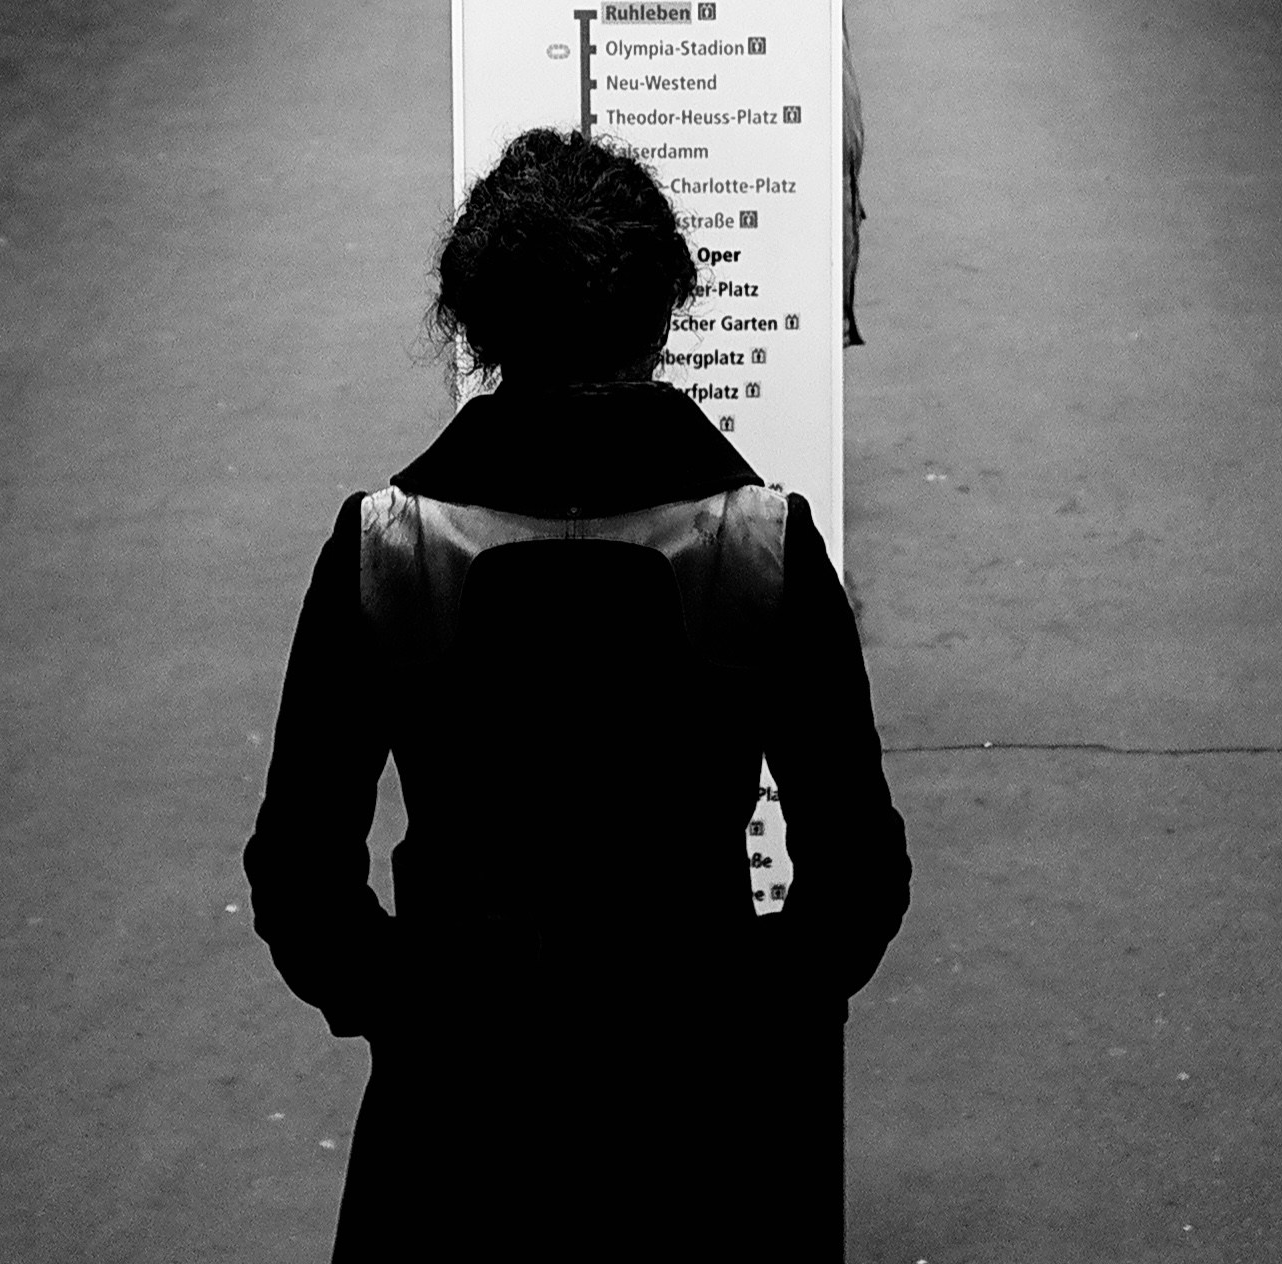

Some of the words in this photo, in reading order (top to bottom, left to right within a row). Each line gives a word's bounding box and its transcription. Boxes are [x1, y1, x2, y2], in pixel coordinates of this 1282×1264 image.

[605, 5, 691, 21] Ruhleben
[605, 40, 745, 61] Olympia-Stadion
[605, 75, 718, 91] Neu-Westend
[605, 109, 779, 126] Theodor-Heuss-Platz
[697, 246, 741, 267] Oper
[670, 315, 716, 332] scher
[721, 315, 778, 332] Garten
[664, 348, 745, 370] bergplatz
